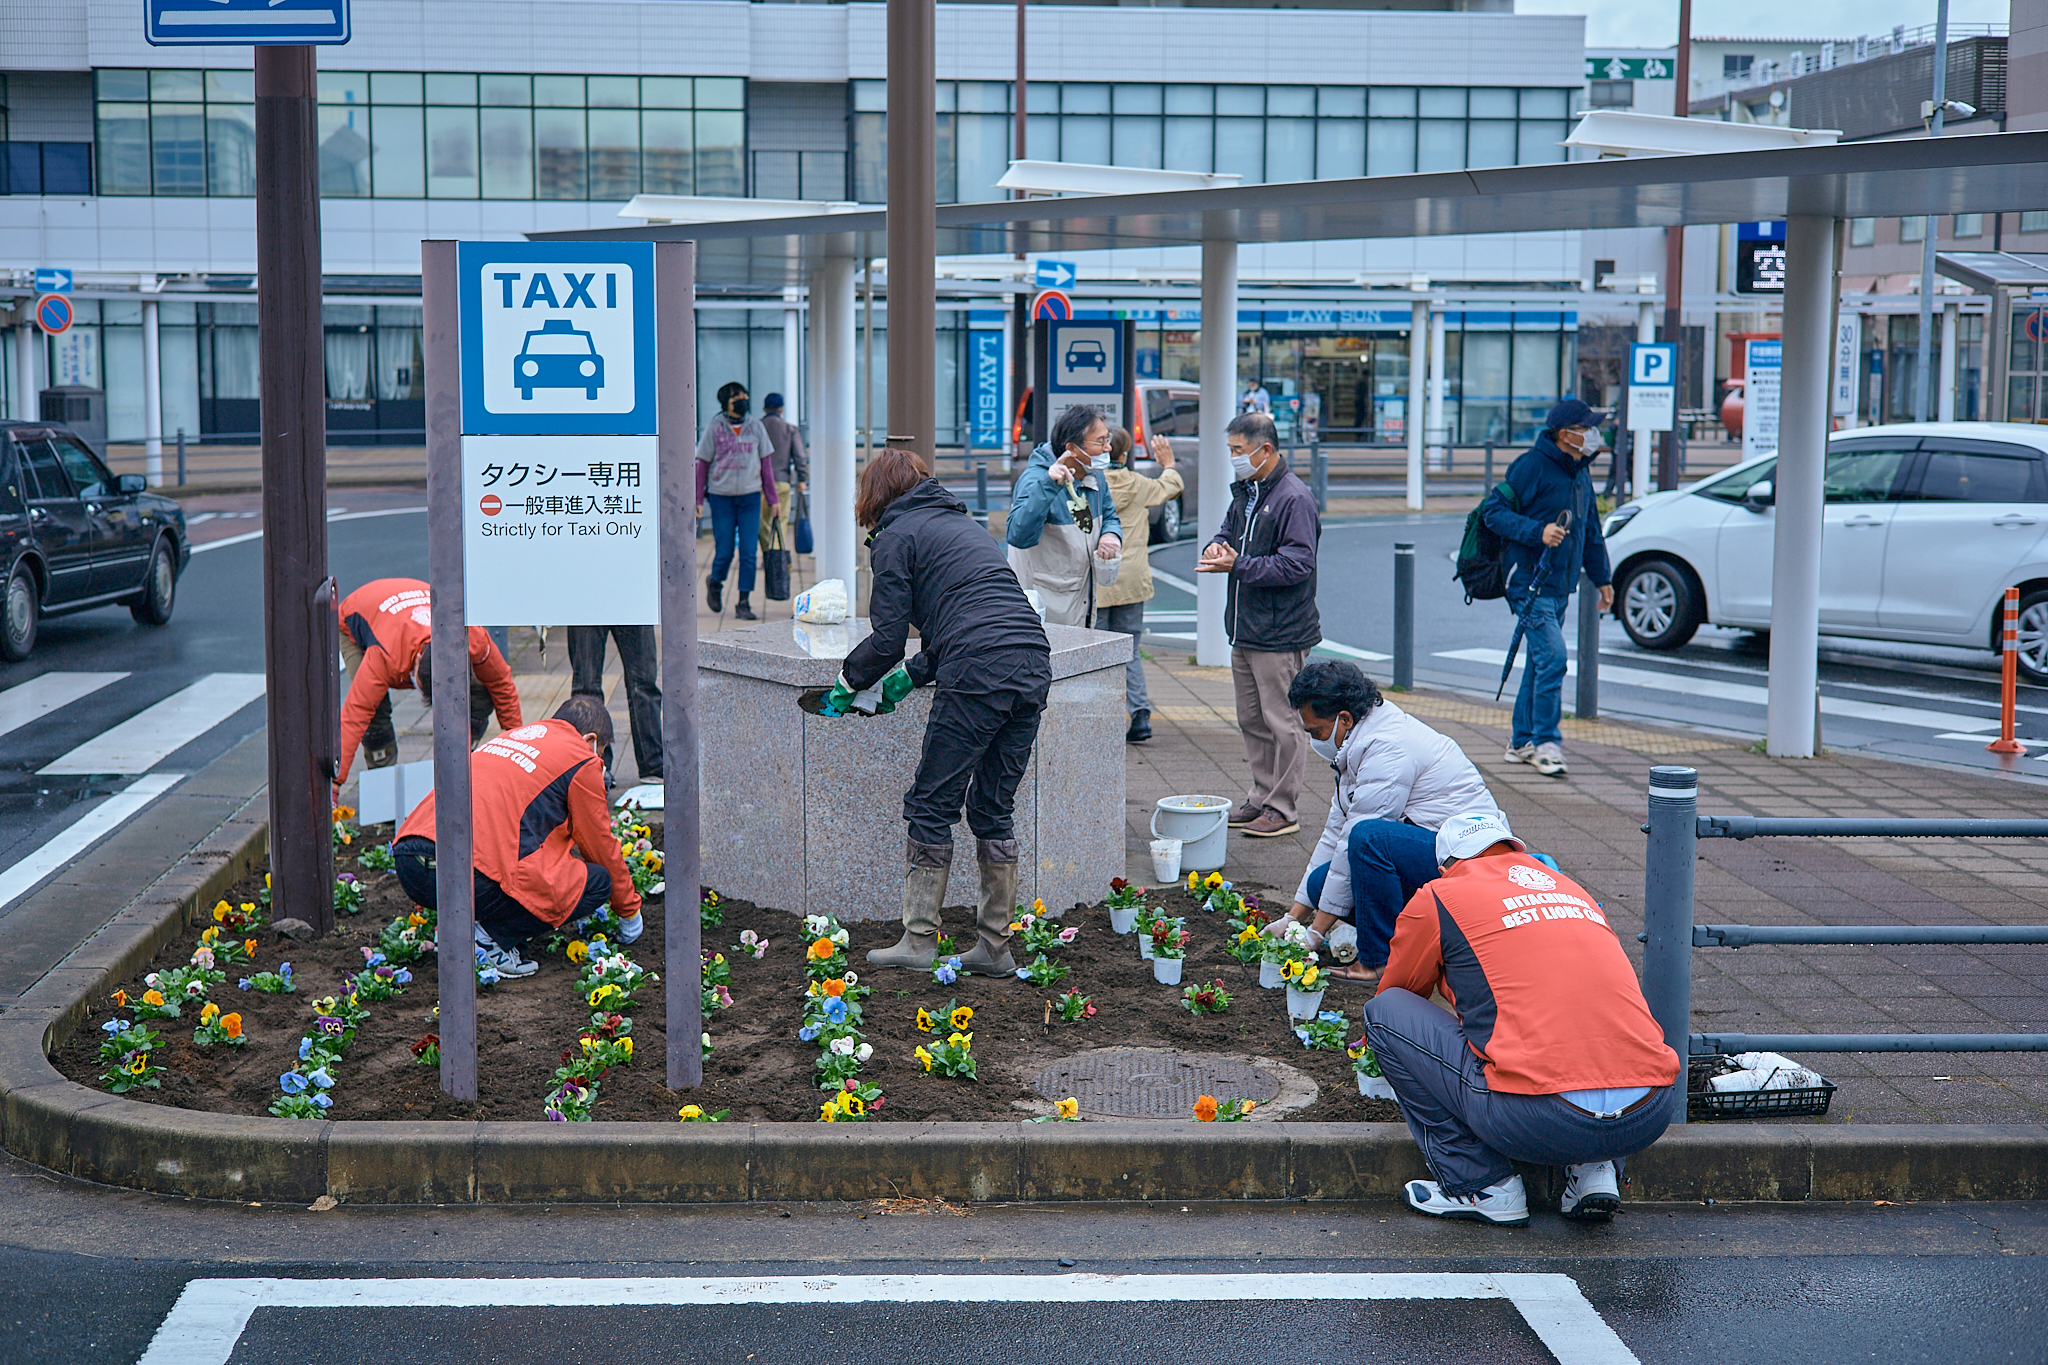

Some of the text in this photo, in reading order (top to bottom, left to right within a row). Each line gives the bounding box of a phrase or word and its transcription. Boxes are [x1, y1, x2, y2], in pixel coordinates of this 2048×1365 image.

[494, 273, 616, 308] TAXI
[1644, 354, 1662, 377] P
[979, 336, 997, 443] LAWSON
[481, 461, 641, 487] タクシー専用
[505, 494, 643, 515] 一般車進入禁止
[481, 521, 642, 539] Strictly for Taxi Only
[482, 745, 515, 758] LIONS
[511, 753, 537, 774] CLUB
[1501, 908, 1541, 929] BEST
[1540, 905, 1585, 920] LIONS
